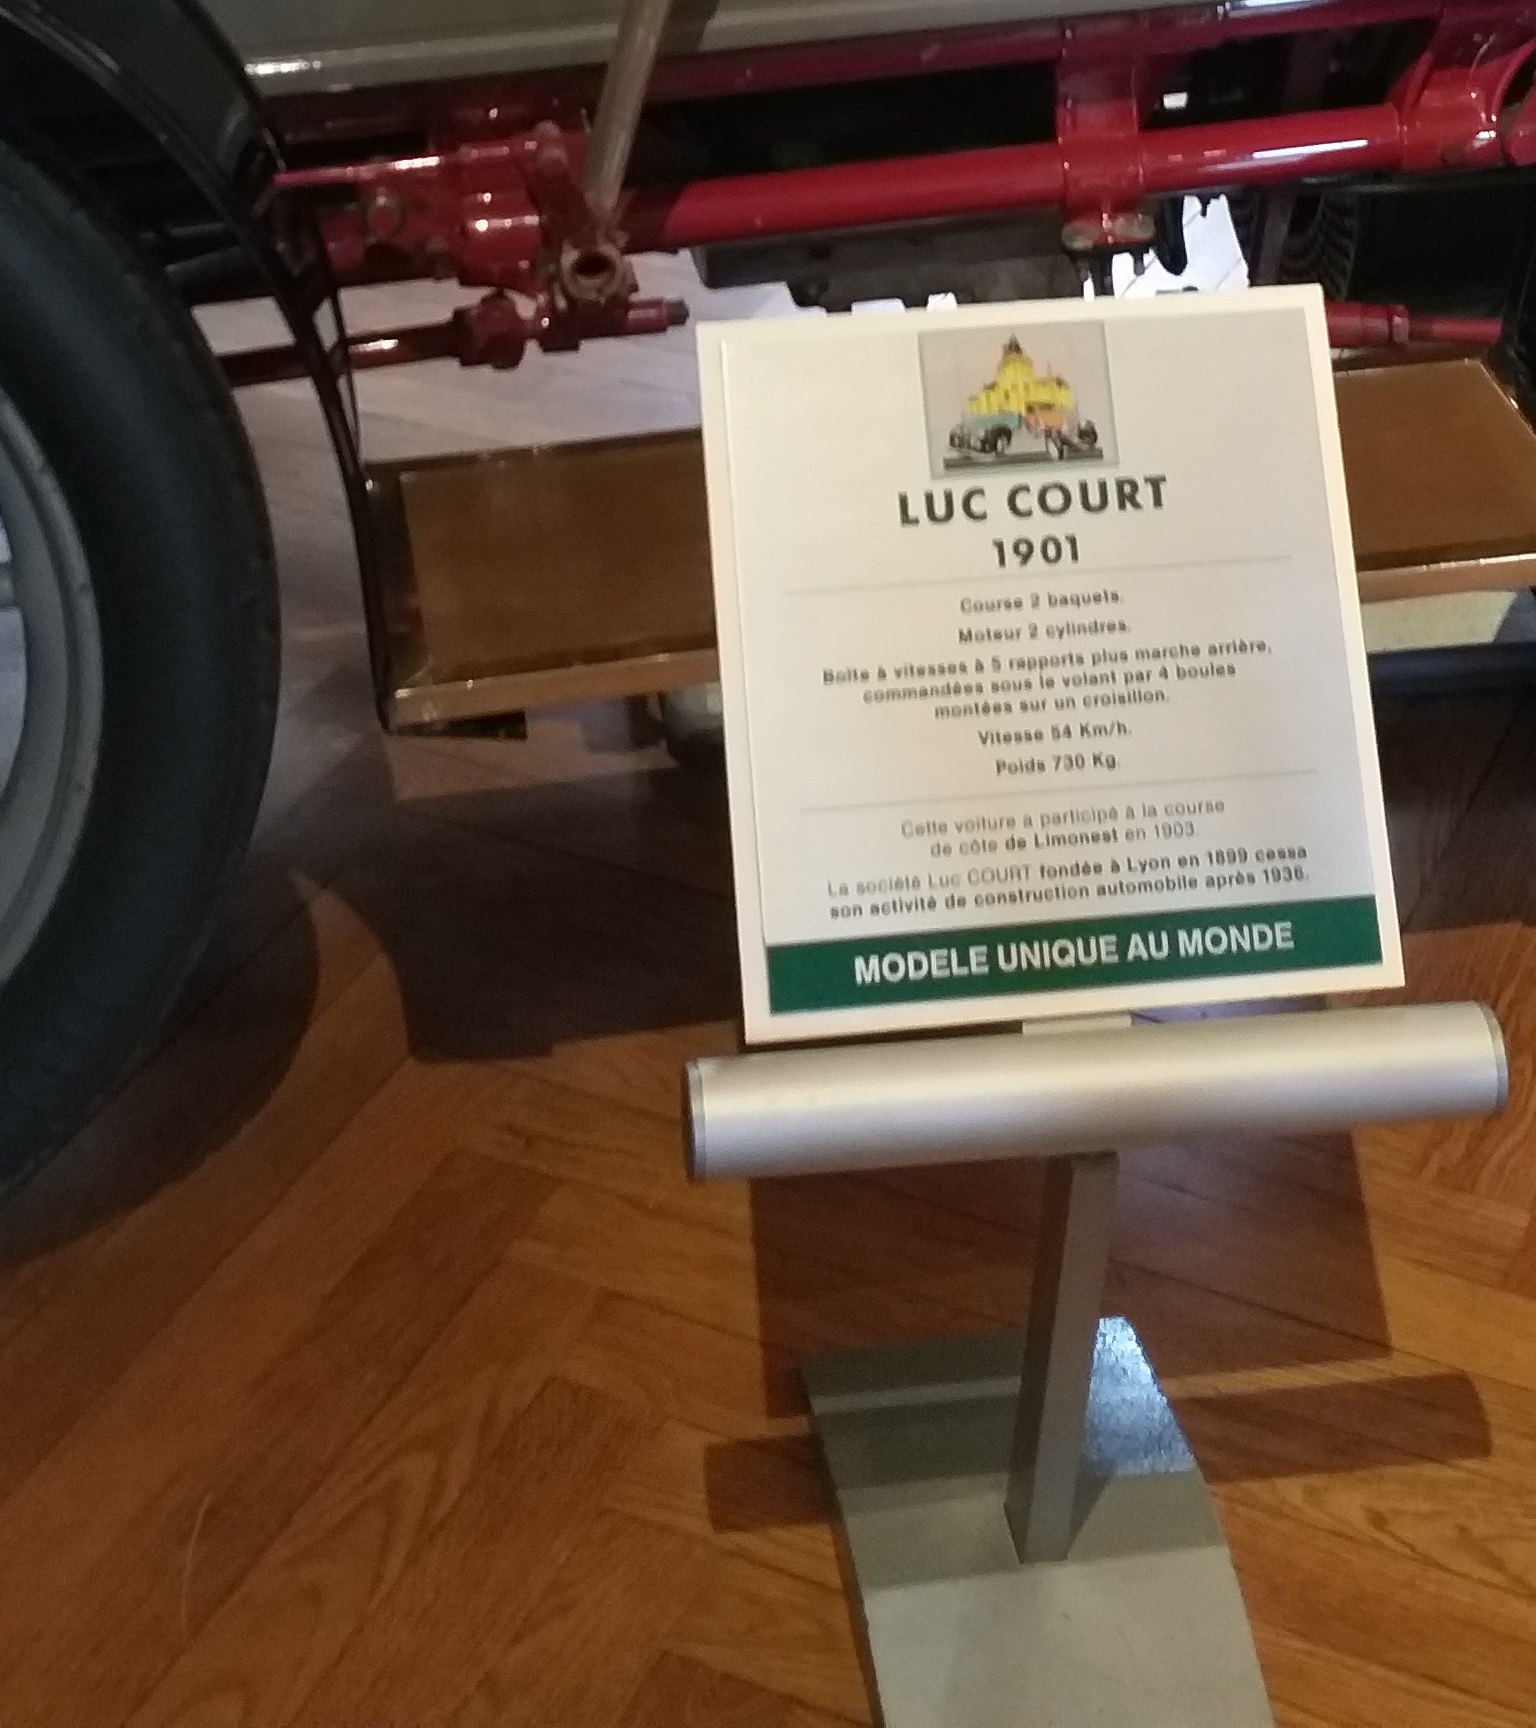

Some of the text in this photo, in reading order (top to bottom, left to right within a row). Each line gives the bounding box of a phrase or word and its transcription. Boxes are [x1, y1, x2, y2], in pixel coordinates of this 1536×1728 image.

[898, 475, 1166, 526] LUC COURT
[992, 533, 1078, 567] 1901
[961, 588, 1123, 614] Course 2 baquets.
[959, 619, 1131, 643] Moteur 2 cylindres.
[894, 661, 967, 679] vitesses
[1009, 650, 1084, 673] rapports
[1092, 648, 1128, 666] plus
[1135, 643, 1200, 661] marche
[863, 662, 1236, 703] commandées sous le volant par 4 boules
[935, 699, 1012, 719] montées
[1020, 697, 1046, 712] sur
[1054, 695, 1076, 711] un
[978, 728, 1044, 746] Vitesse
[1079, 720, 1131, 739] Km/h.
[996, 757, 1046, 776] Poids
[901, 819, 947, 839] Cette
[955, 815, 1016, 834] voiture
[1040, 805, 1118, 829] participé
[1142, 802, 1158, 819] la
[1164, 799, 1225, 817] course
[930, 841, 952, 857] de
[959, 838, 998, 857] côte
[1005, 834, 1027, 852] de
[1034, 827, 1118, 849] Limonest
[1125, 826, 1146, 842] en
[828, 880, 849, 897] La
[856, 874, 921, 896] société
[928, 872, 962, 890] Luc
[967, 863, 1032, 886] COURT
[1040, 859, 1103, 880] fondée
[1126, 854, 1171, 874] Lyon
[1177, 853, 1200, 869] en
[1254, 844, 1307, 863] cessa
[830, 904, 863, 919] son
[870, 895, 937, 917] activité
[945, 893, 966, 910] de
[974, 884, 1089, 909] construction
[1096, 874, 1198, 898] automobile
[1205, 869, 1256, 891] après
[854, 921, 1294, 986] MODELE UNIQUE AU MONDE
